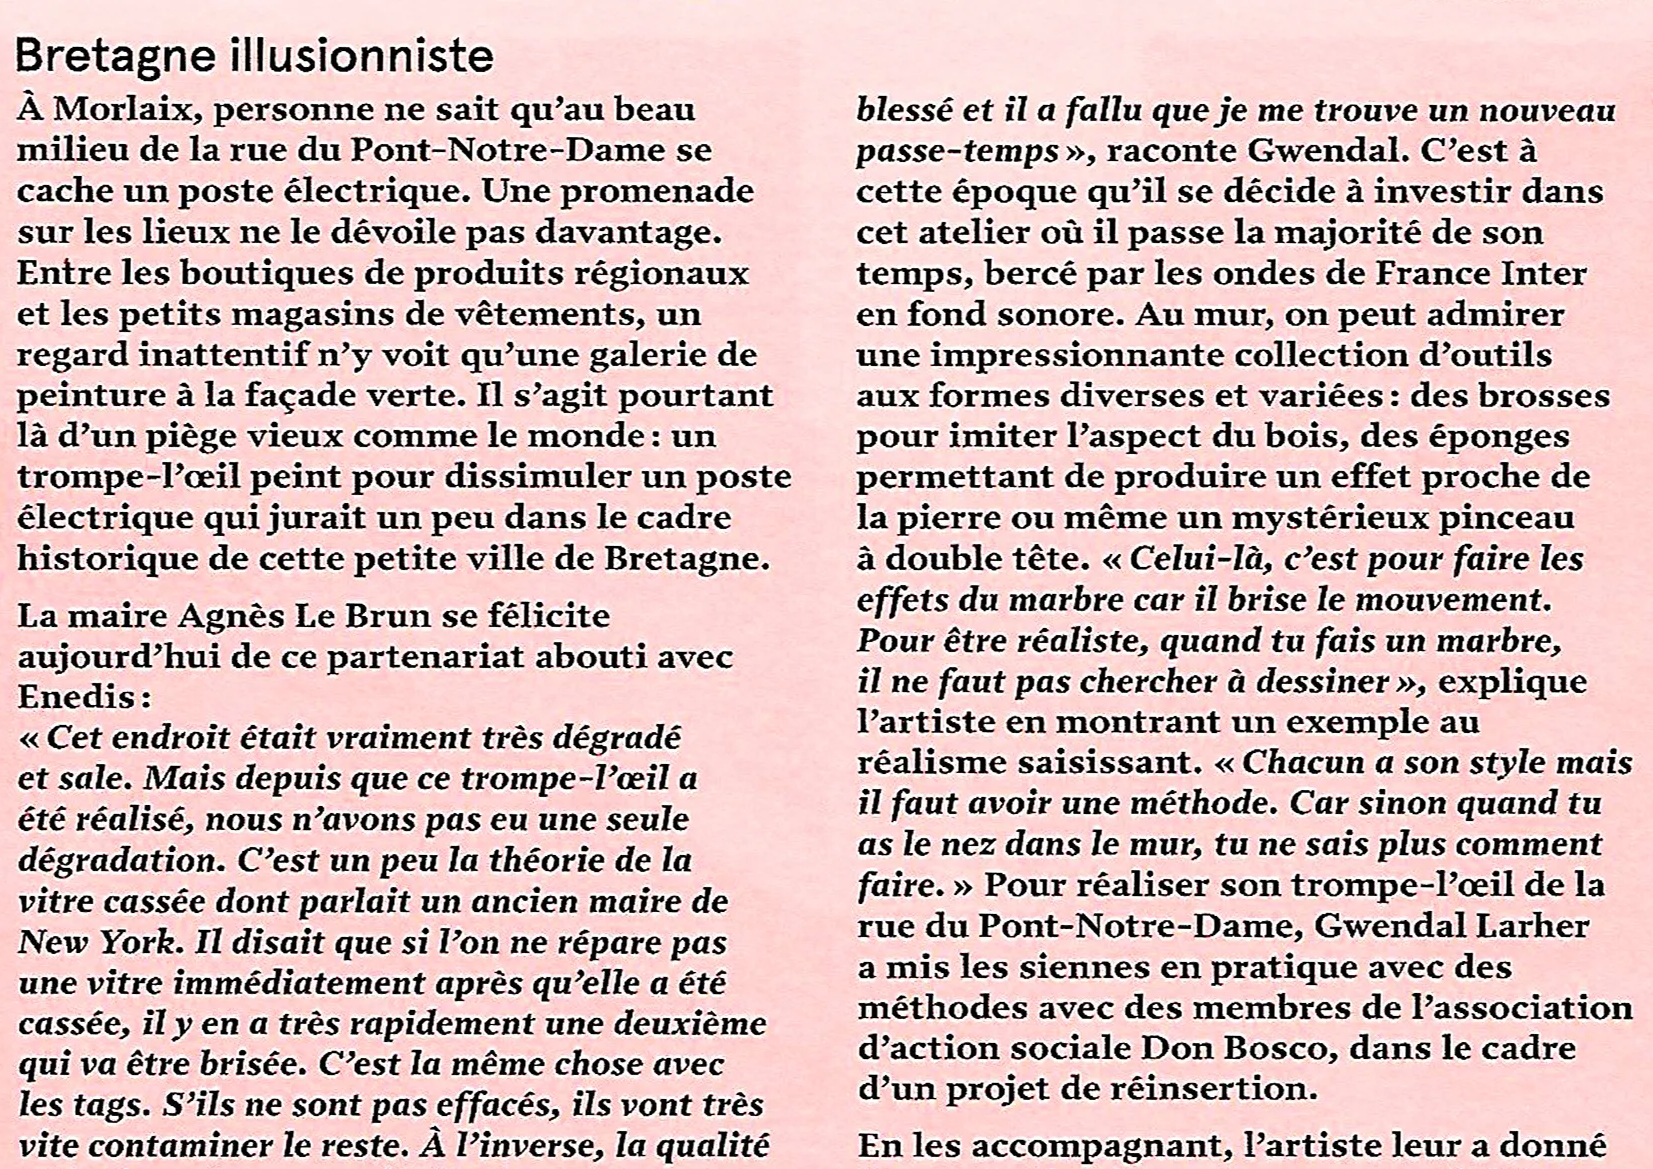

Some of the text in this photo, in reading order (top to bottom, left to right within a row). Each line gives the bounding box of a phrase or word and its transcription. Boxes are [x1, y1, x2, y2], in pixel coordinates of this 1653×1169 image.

[17, 36, 493, 81] Bretagne illusionniste
[16, 90, 696, 128] À Morlaix, personne ne sait qu'au beau
[857, 299, 1565, 333] en fond sonore. Au mur, on peut admirer
